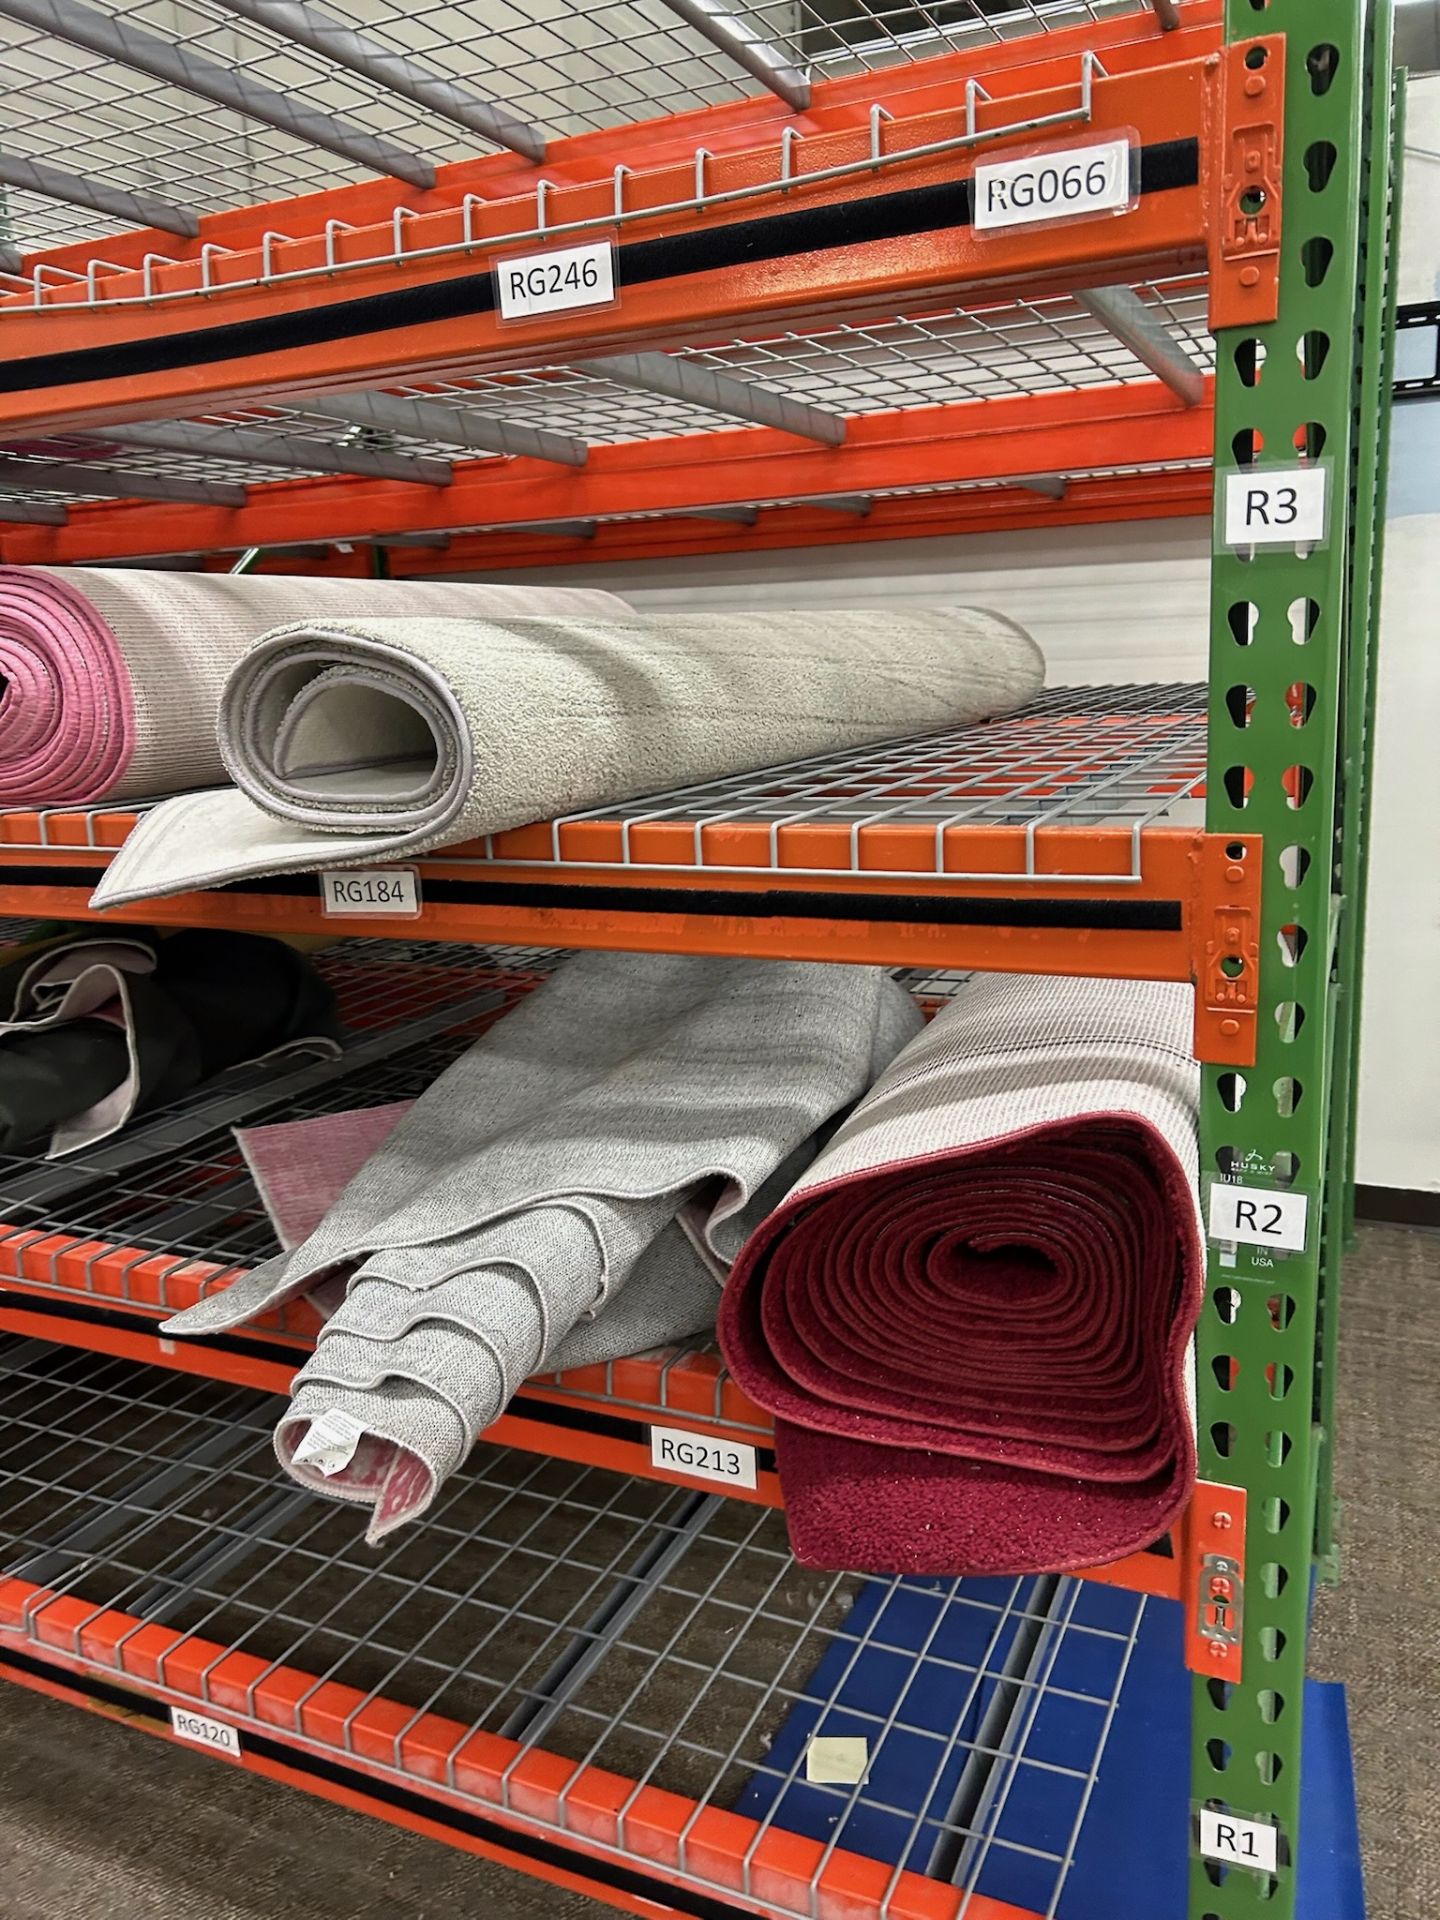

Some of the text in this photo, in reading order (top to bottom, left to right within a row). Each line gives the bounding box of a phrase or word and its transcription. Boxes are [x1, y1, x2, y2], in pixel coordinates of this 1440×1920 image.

[988, 160, 1106, 212] RG066
[510, 258, 598, 300] RG246
[1246, 487, 1298, 526] R3
[333, 880, 404, 902] RG184
[1230, 1161, 1275, 1171] HUSKY
[1235, 1200, 1283, 1235] R2
[1251, 1256, 1274, 1268] USA
[661, 1438, 741, 1475] RG213
[177, 1714, 231, 1747] RG120
[1217, 1823, 1259, 1858] R1
